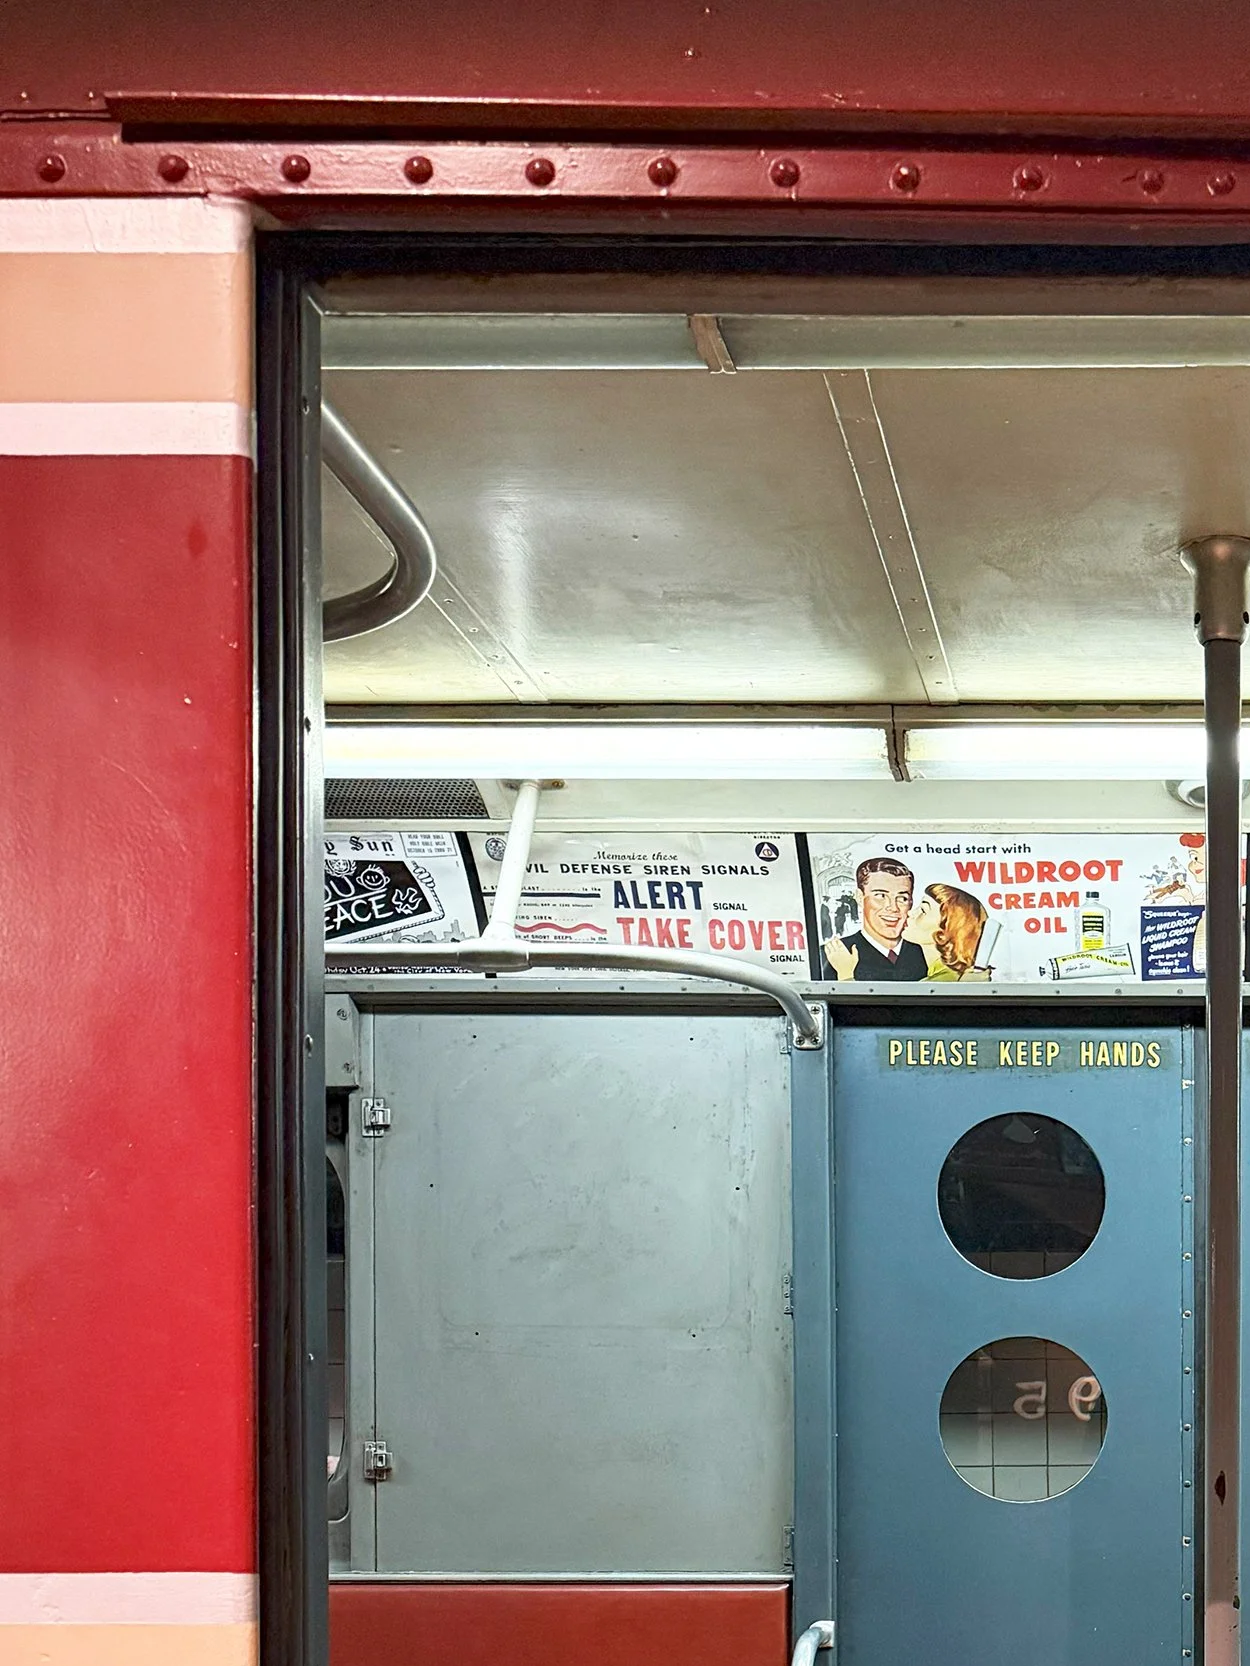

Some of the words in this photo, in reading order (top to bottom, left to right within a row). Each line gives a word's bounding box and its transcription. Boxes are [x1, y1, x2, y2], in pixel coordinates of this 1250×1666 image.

[349, 836, 394, 851] Sun
[885, 843, 909, 853] Get
[926, 844, 960, 854] head
[966, 844, 997, 854] start
[1002, 844, 1031, 853] with
[593, 851, 648, 861] Memorize
[652, 852, 678, 861] these
[560, 863, 632, 874] DEFENSE
[643, 864, 691, 876] SIREN
[702, 864, 770, 876] SIGNALS
[954, 860, 1124, 884] WILDROOT
[614, 880, 703, 910] ALERT
[988, 891, 1080, 910] CREAM
[713, 902, 748, 911] SIGNAL
[1024, 917, 1067, 934] OIL
[616, 917, 693, 949] TAKE
[708, 919, 806, 951] COVER
[770, 954, 805, 963] SIGNAL
[889, 1039, 978, 1067] PLEASE
[999, 1040, 1061, 1067] KEEP
[1080, 1041, 1161, 1068] HANDS
